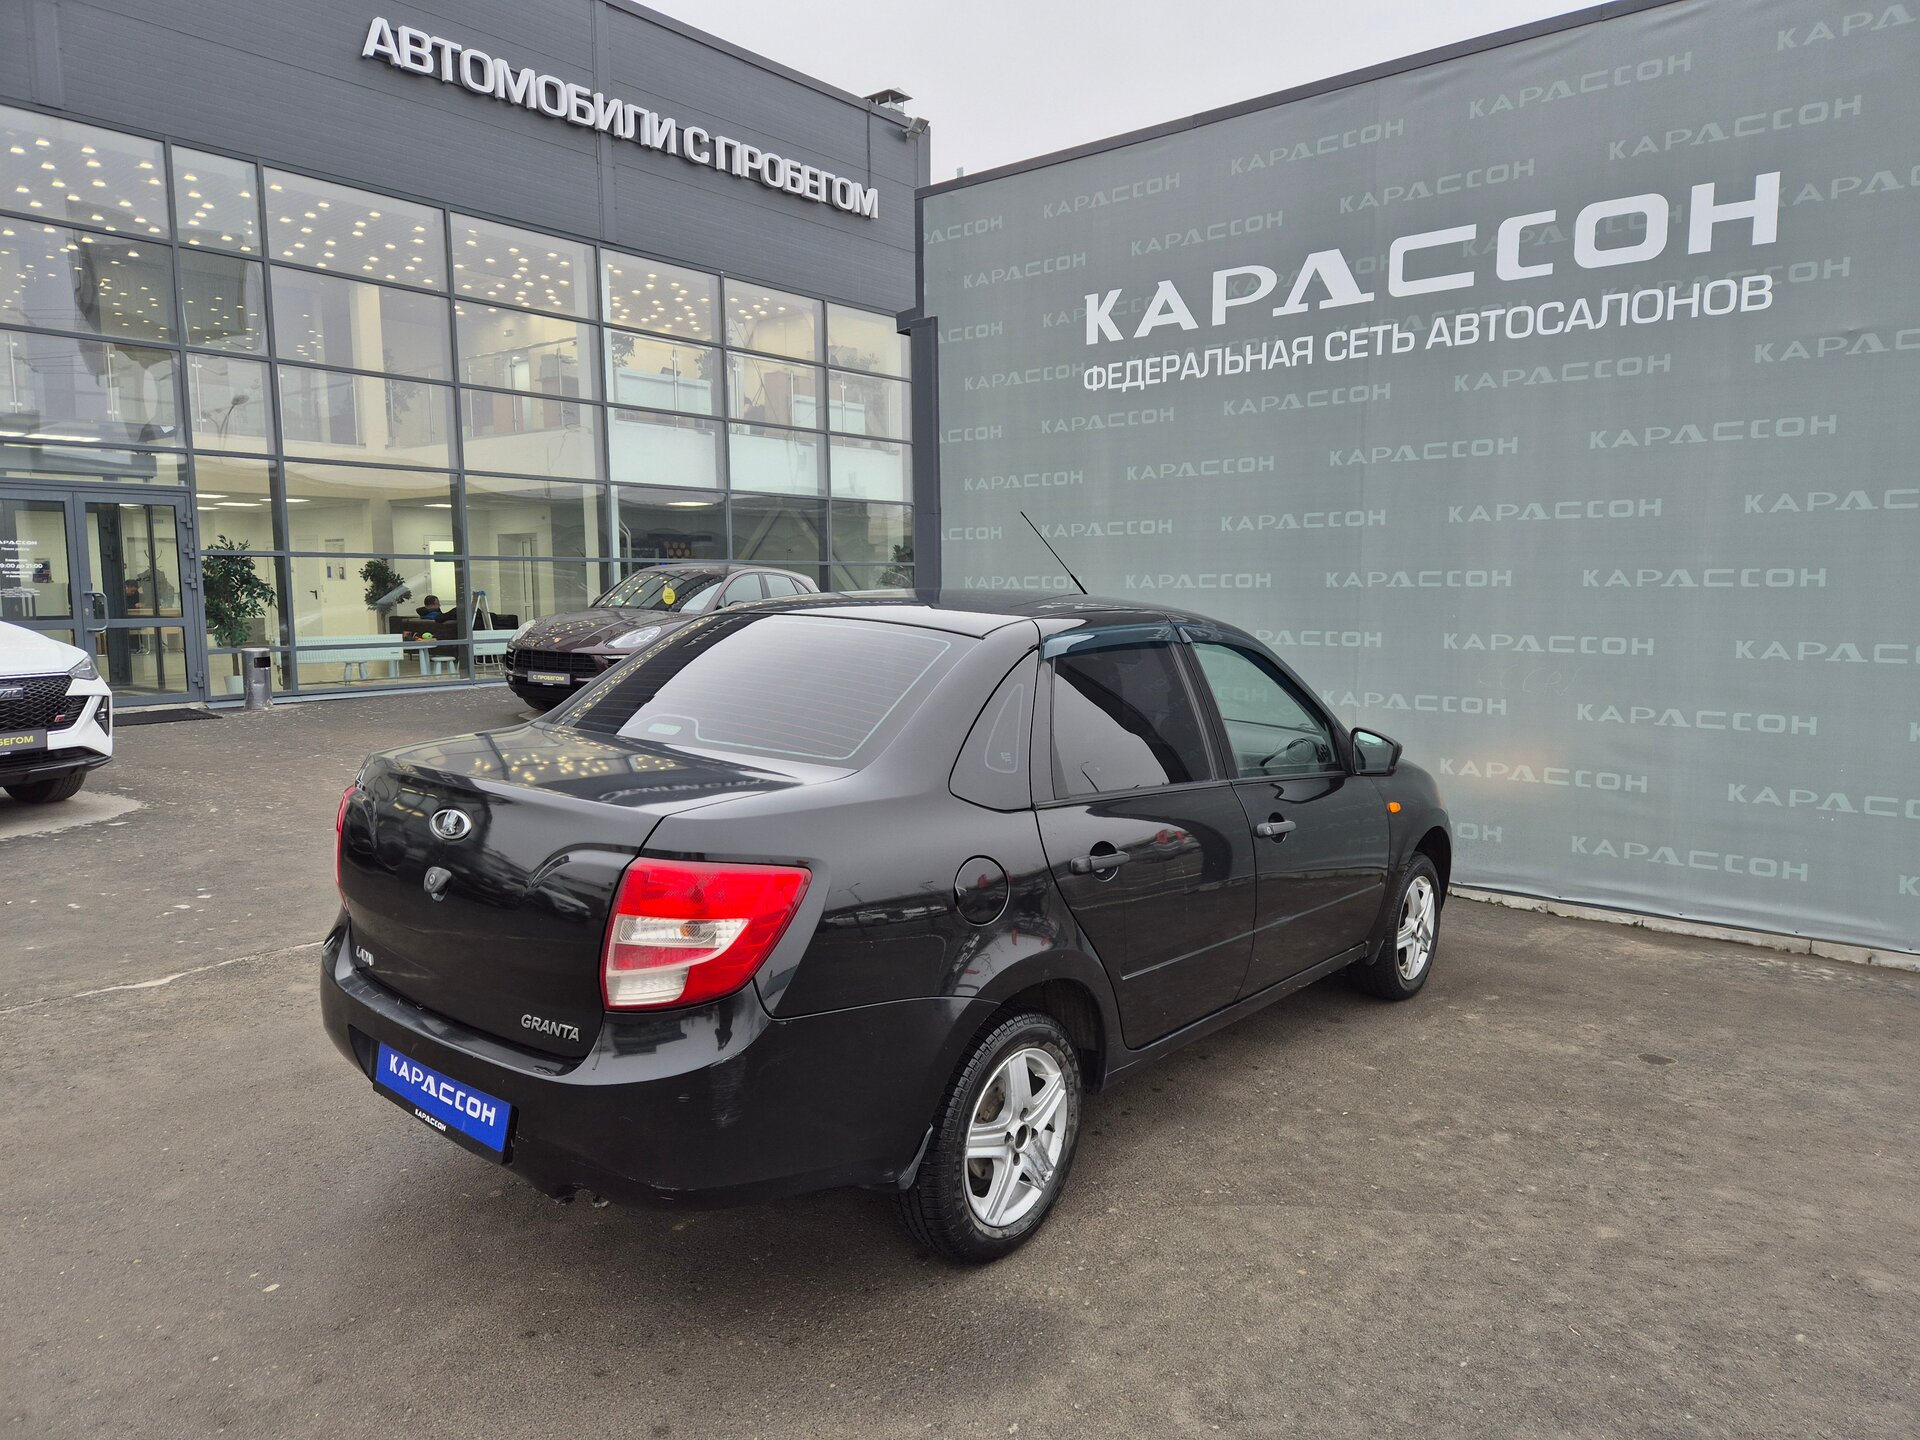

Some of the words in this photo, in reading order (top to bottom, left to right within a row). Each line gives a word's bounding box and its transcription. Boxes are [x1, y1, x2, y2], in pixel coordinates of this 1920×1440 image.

[361, 16, 677, 155] АВТОМОБИЛИ
[683, 126, 710, 165] С
[715, 135, 879, 219] ПРОБЕГОМ
[1083, 335, 1314, 392] ФЕДЕРАЛЬНАЯ
[1324, 324, 1415, 362] СЕТЬ
[1425, 274, 1774, 350] АВТОСАЛОНОВ
[521, 1014, 580, 1042] GRANTA
